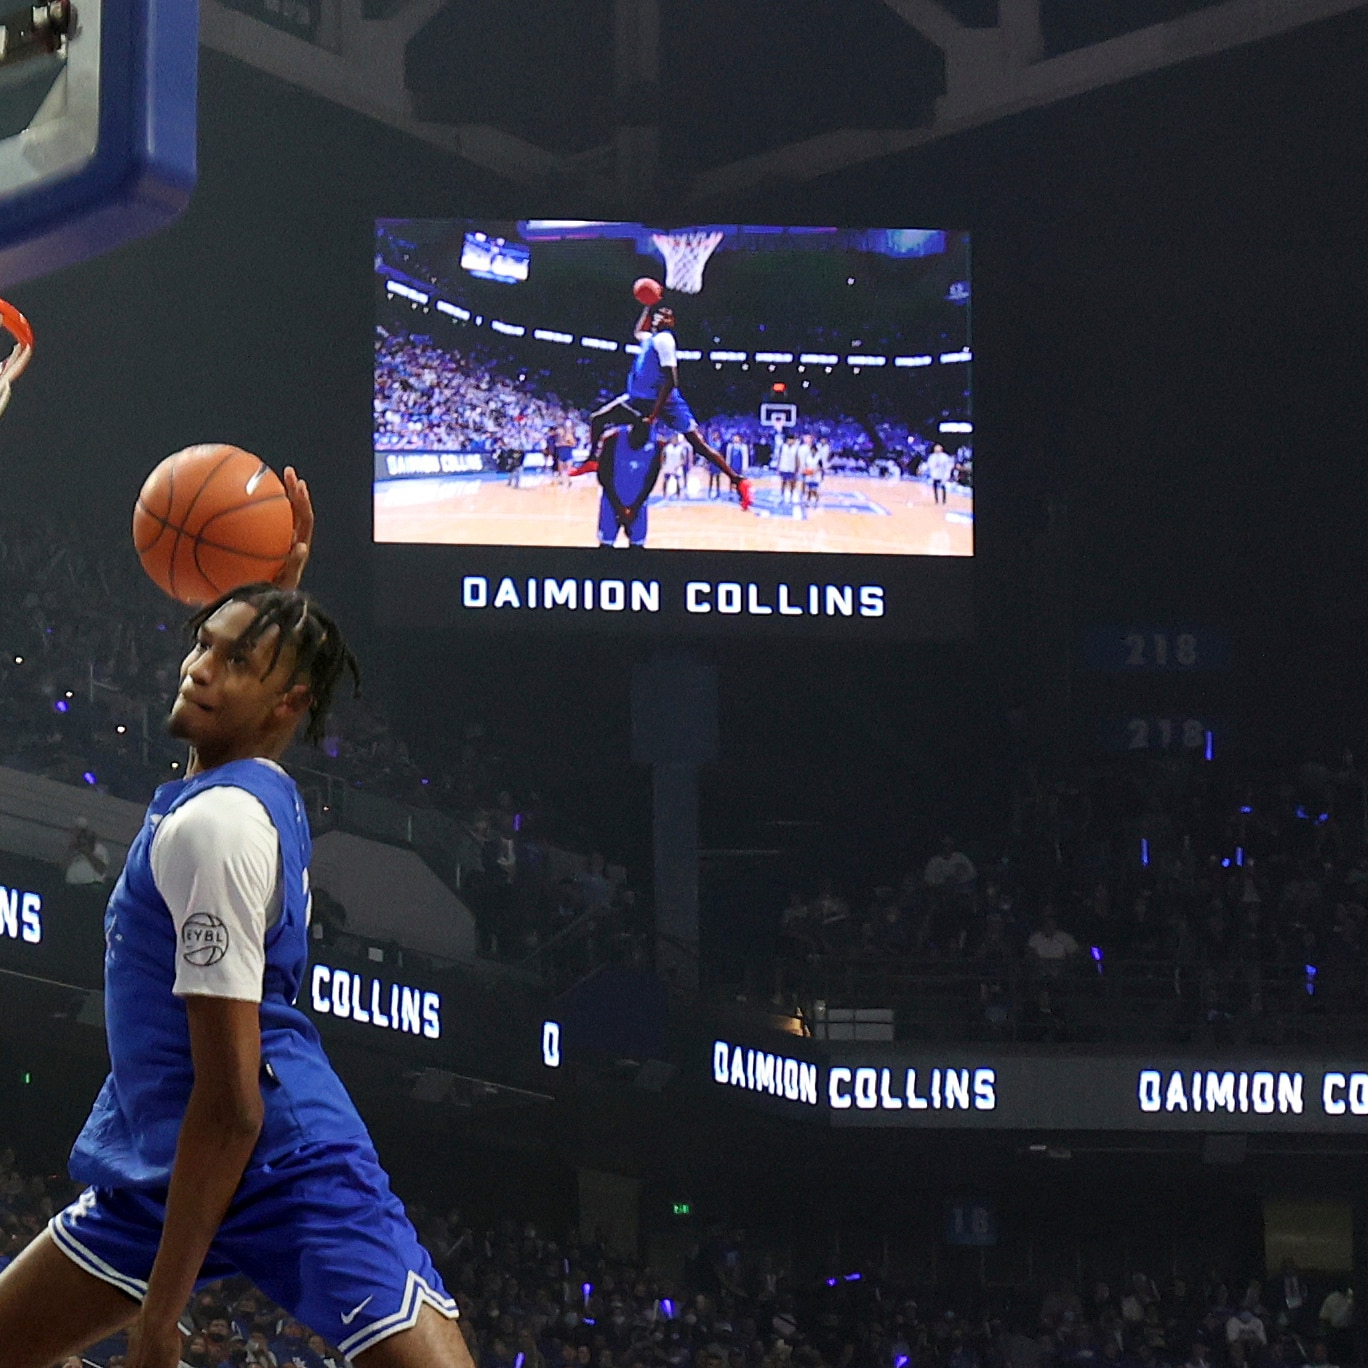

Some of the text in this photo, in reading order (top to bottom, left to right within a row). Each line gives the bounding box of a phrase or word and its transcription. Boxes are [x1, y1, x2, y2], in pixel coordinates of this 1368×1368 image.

[463, 576, 884, 617] DAIMION COLLINS
[1125, 633, 1199, 666] 218
[186, 929, 223, 943] EYBL
[311, 964, 441, 1039] COLLINS
[713, 1041, 996, 1110] DAIMION COLLINS
[1139, 1070, 1303, 1114] DAIMION
